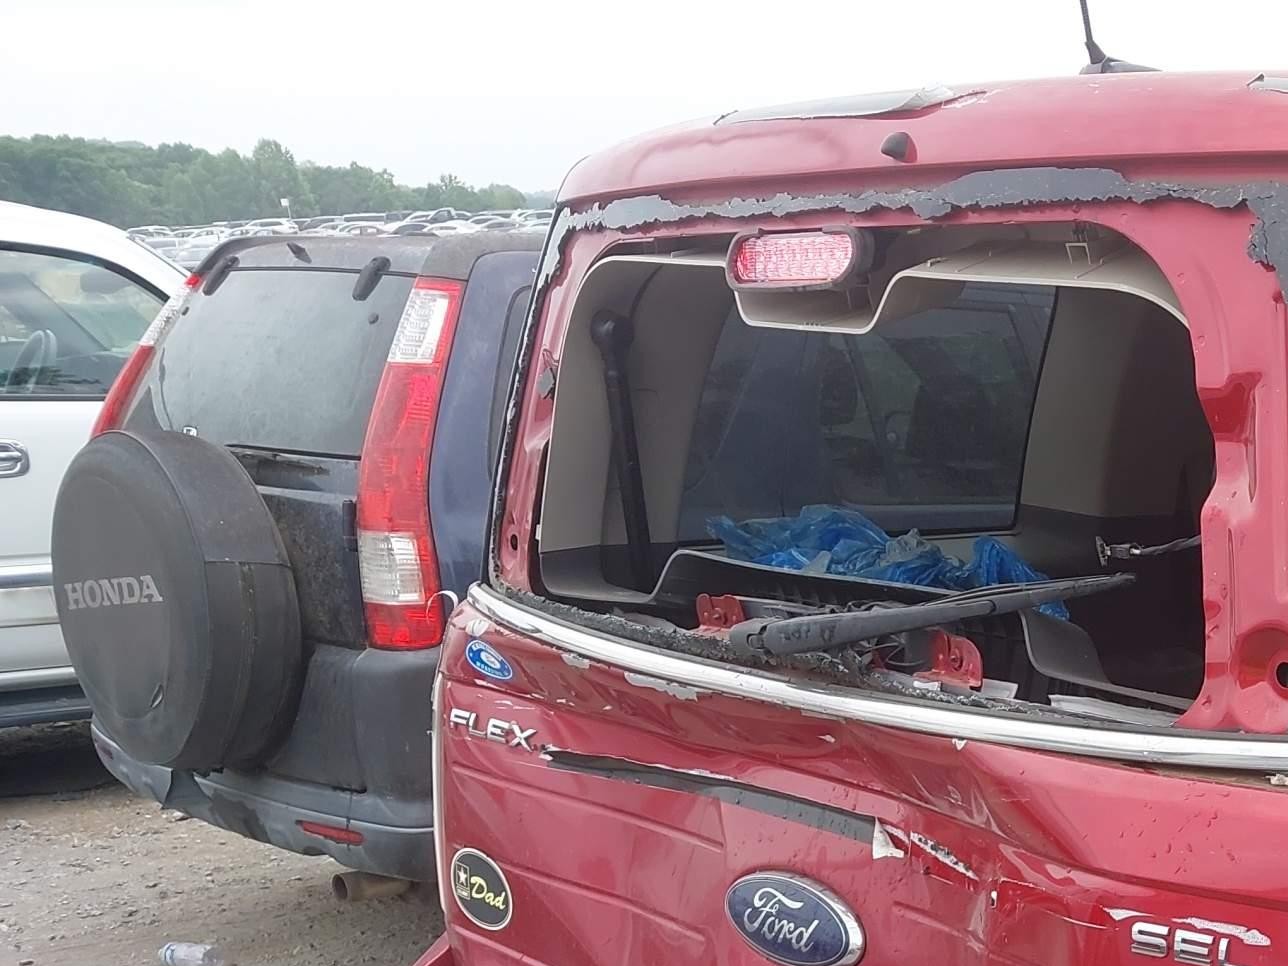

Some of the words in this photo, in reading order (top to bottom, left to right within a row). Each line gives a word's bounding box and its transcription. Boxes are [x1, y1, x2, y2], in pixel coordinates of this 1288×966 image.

[64, 575, 163, 610] HONDA
[450, 708, 537, 752] FLEX
[470, 876, 506, 910] Dad
[743, 887, 820, 953] Ford
